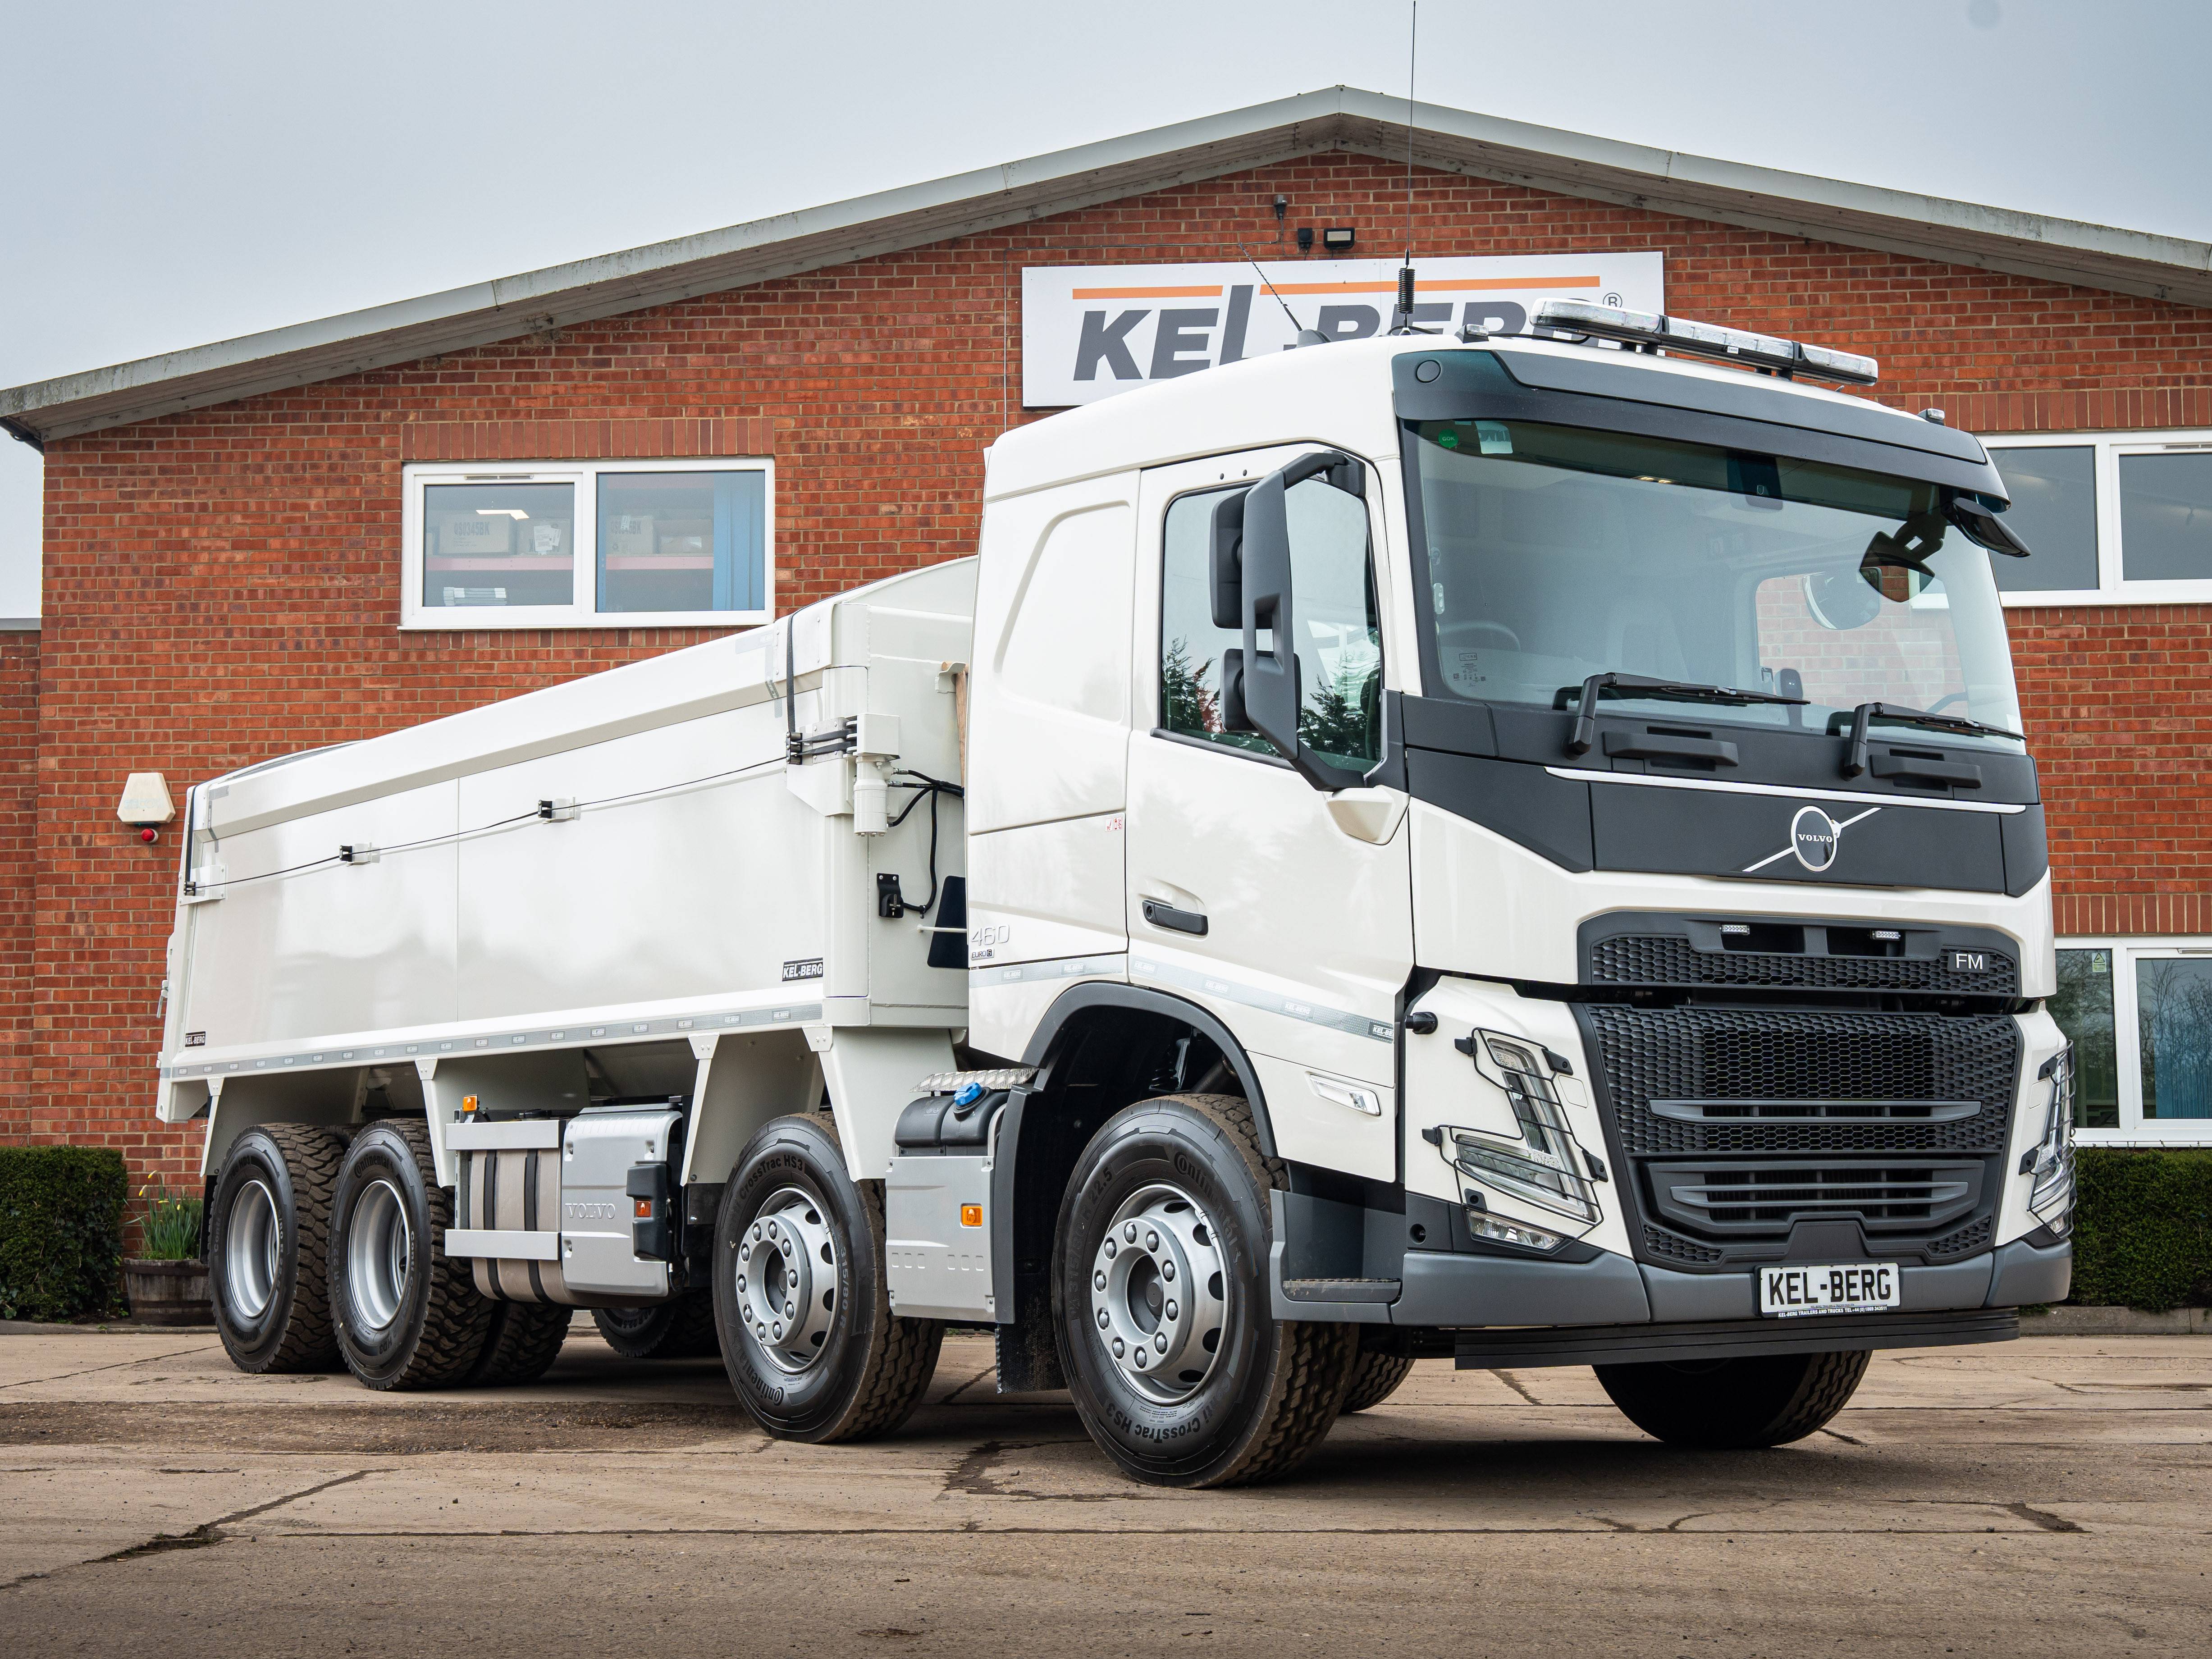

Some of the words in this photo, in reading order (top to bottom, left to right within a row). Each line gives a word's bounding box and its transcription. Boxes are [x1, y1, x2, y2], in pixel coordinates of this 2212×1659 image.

[1797, 834, 1833, 843] VOLVO
[971, 924, 1010, 946] 460
[1956, 954, 1983, 969] FM
[783, 963, 823, 978] KEL-BERG
[1284, 1003, 1311, 1014] KEL-BERG
[185, 1036, 205, 1045] KEL-BERG
[740, 1157, 782, 1200] CrossTrac
[783, 1154, 803, 1171] HS3
[1087, 1166, 1112, 1205] 22.5
[564, 1203, 616, 1220] VOLVO
[1769, 1269, 1891, 1306] KEL-BERG
[839, 1315, 847, 1329] R
[1106, 1403, 1132, 1434] HS3
[1134, 1417, 1201, 1444] CrossTrac
